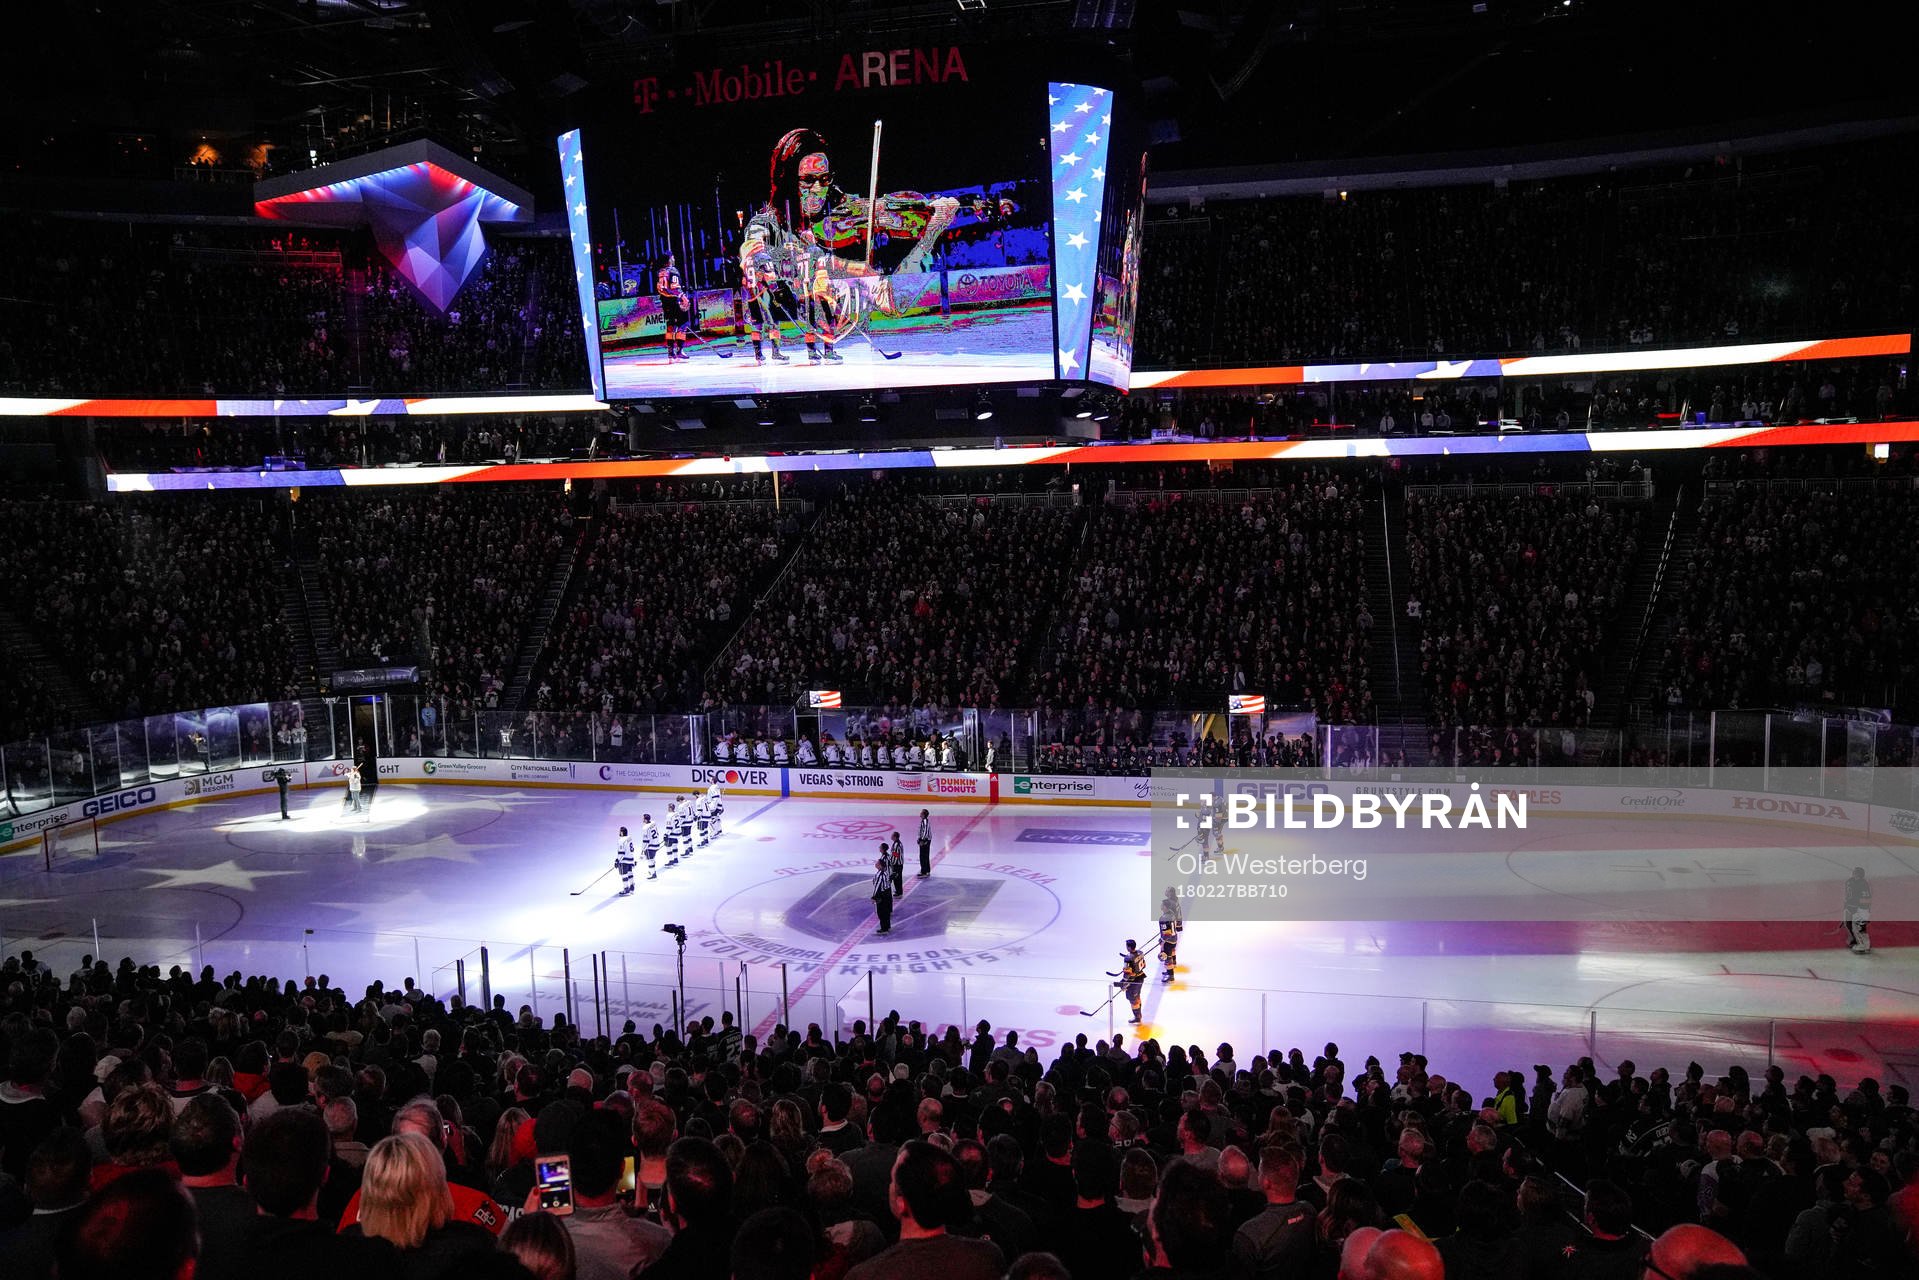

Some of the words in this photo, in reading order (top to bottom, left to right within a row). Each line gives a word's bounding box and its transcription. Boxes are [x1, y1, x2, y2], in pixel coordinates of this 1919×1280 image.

[834, 46, 969, 92] ARENA
[979, 273, 1034, 291] TOYOTA
[202, 774, 234, 787] MGM
[692, 769, 768, 785] DISCOVER
[799, 773, 833, 786] VEGAS
[844, 774, 884, 787] STRONG
[202, 783, 235, 793] RESORTS
[941, 785, 977, 793] DONUTS
[1016, 779, 1093, 793] enterprise
[1237, 782, 1329, 800] GEICO
[83, 786, 156, 818] GEICO
[1732, 797, 1850, 820] HONDA
[1, 811, 68, 838] enterprise
[801, 832, 886, 841] TOYOTA
[982, 861, 1059, 885] ARENA
[699, 939, 820, 973] GOLDEN
[839, 952, 1000, 975] KNIGHTS
[847, 948, 963, 962] SEASON
